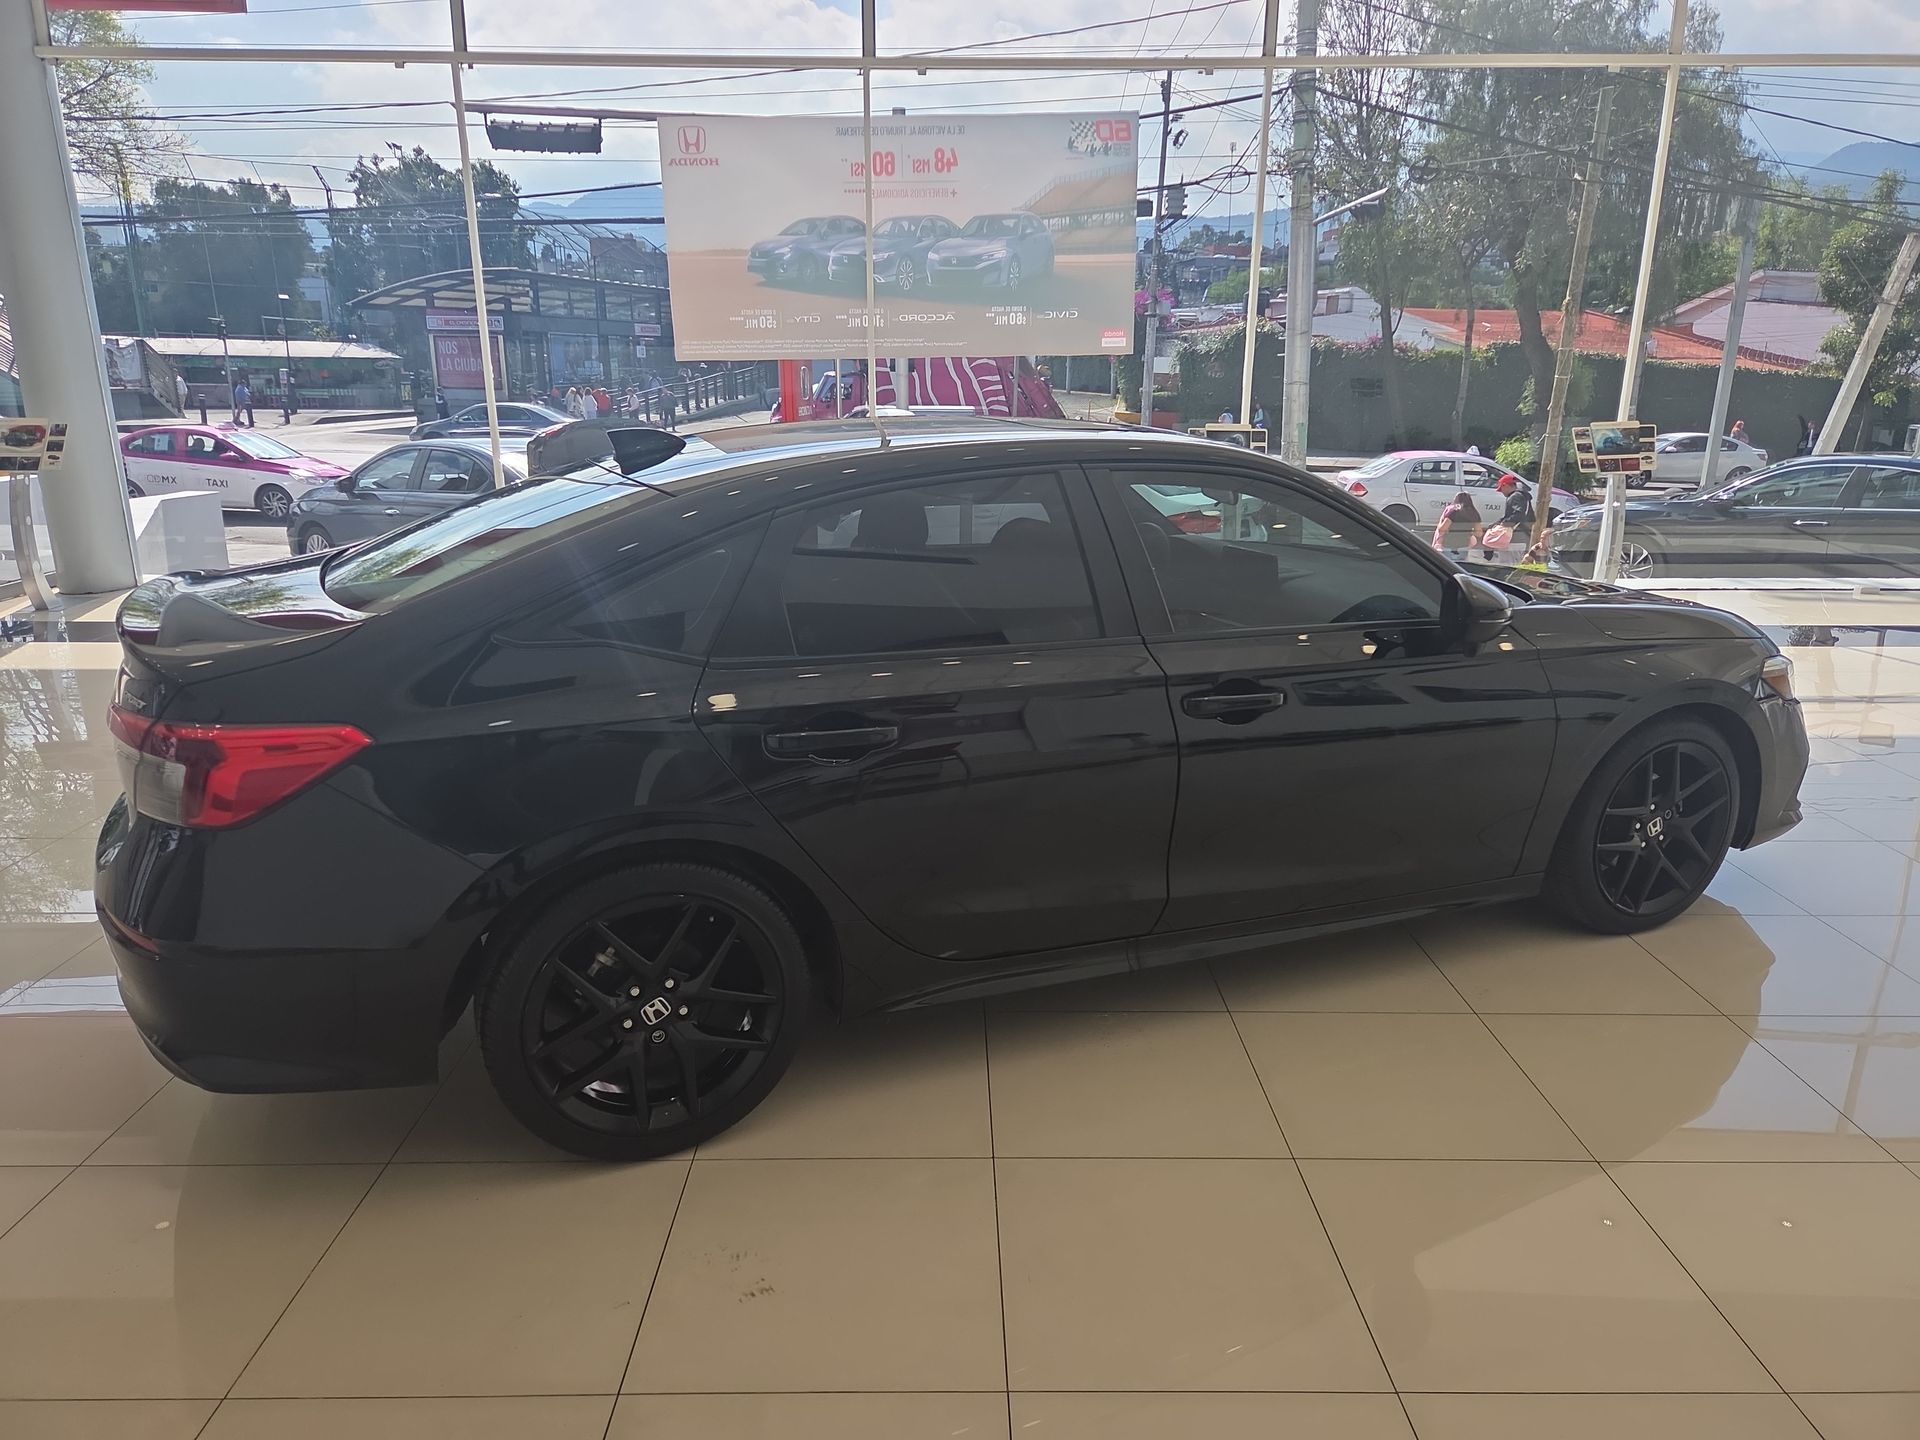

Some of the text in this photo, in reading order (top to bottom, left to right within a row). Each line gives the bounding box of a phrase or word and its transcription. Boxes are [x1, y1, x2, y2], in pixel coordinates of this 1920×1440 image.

[439, 341, 458, 354] NOS
[440, 357, 483, 371] LA CIUDA
[146, 474, 229, 488] CDMX TAXI
[1485, 503, 1501, 511] TAXI
